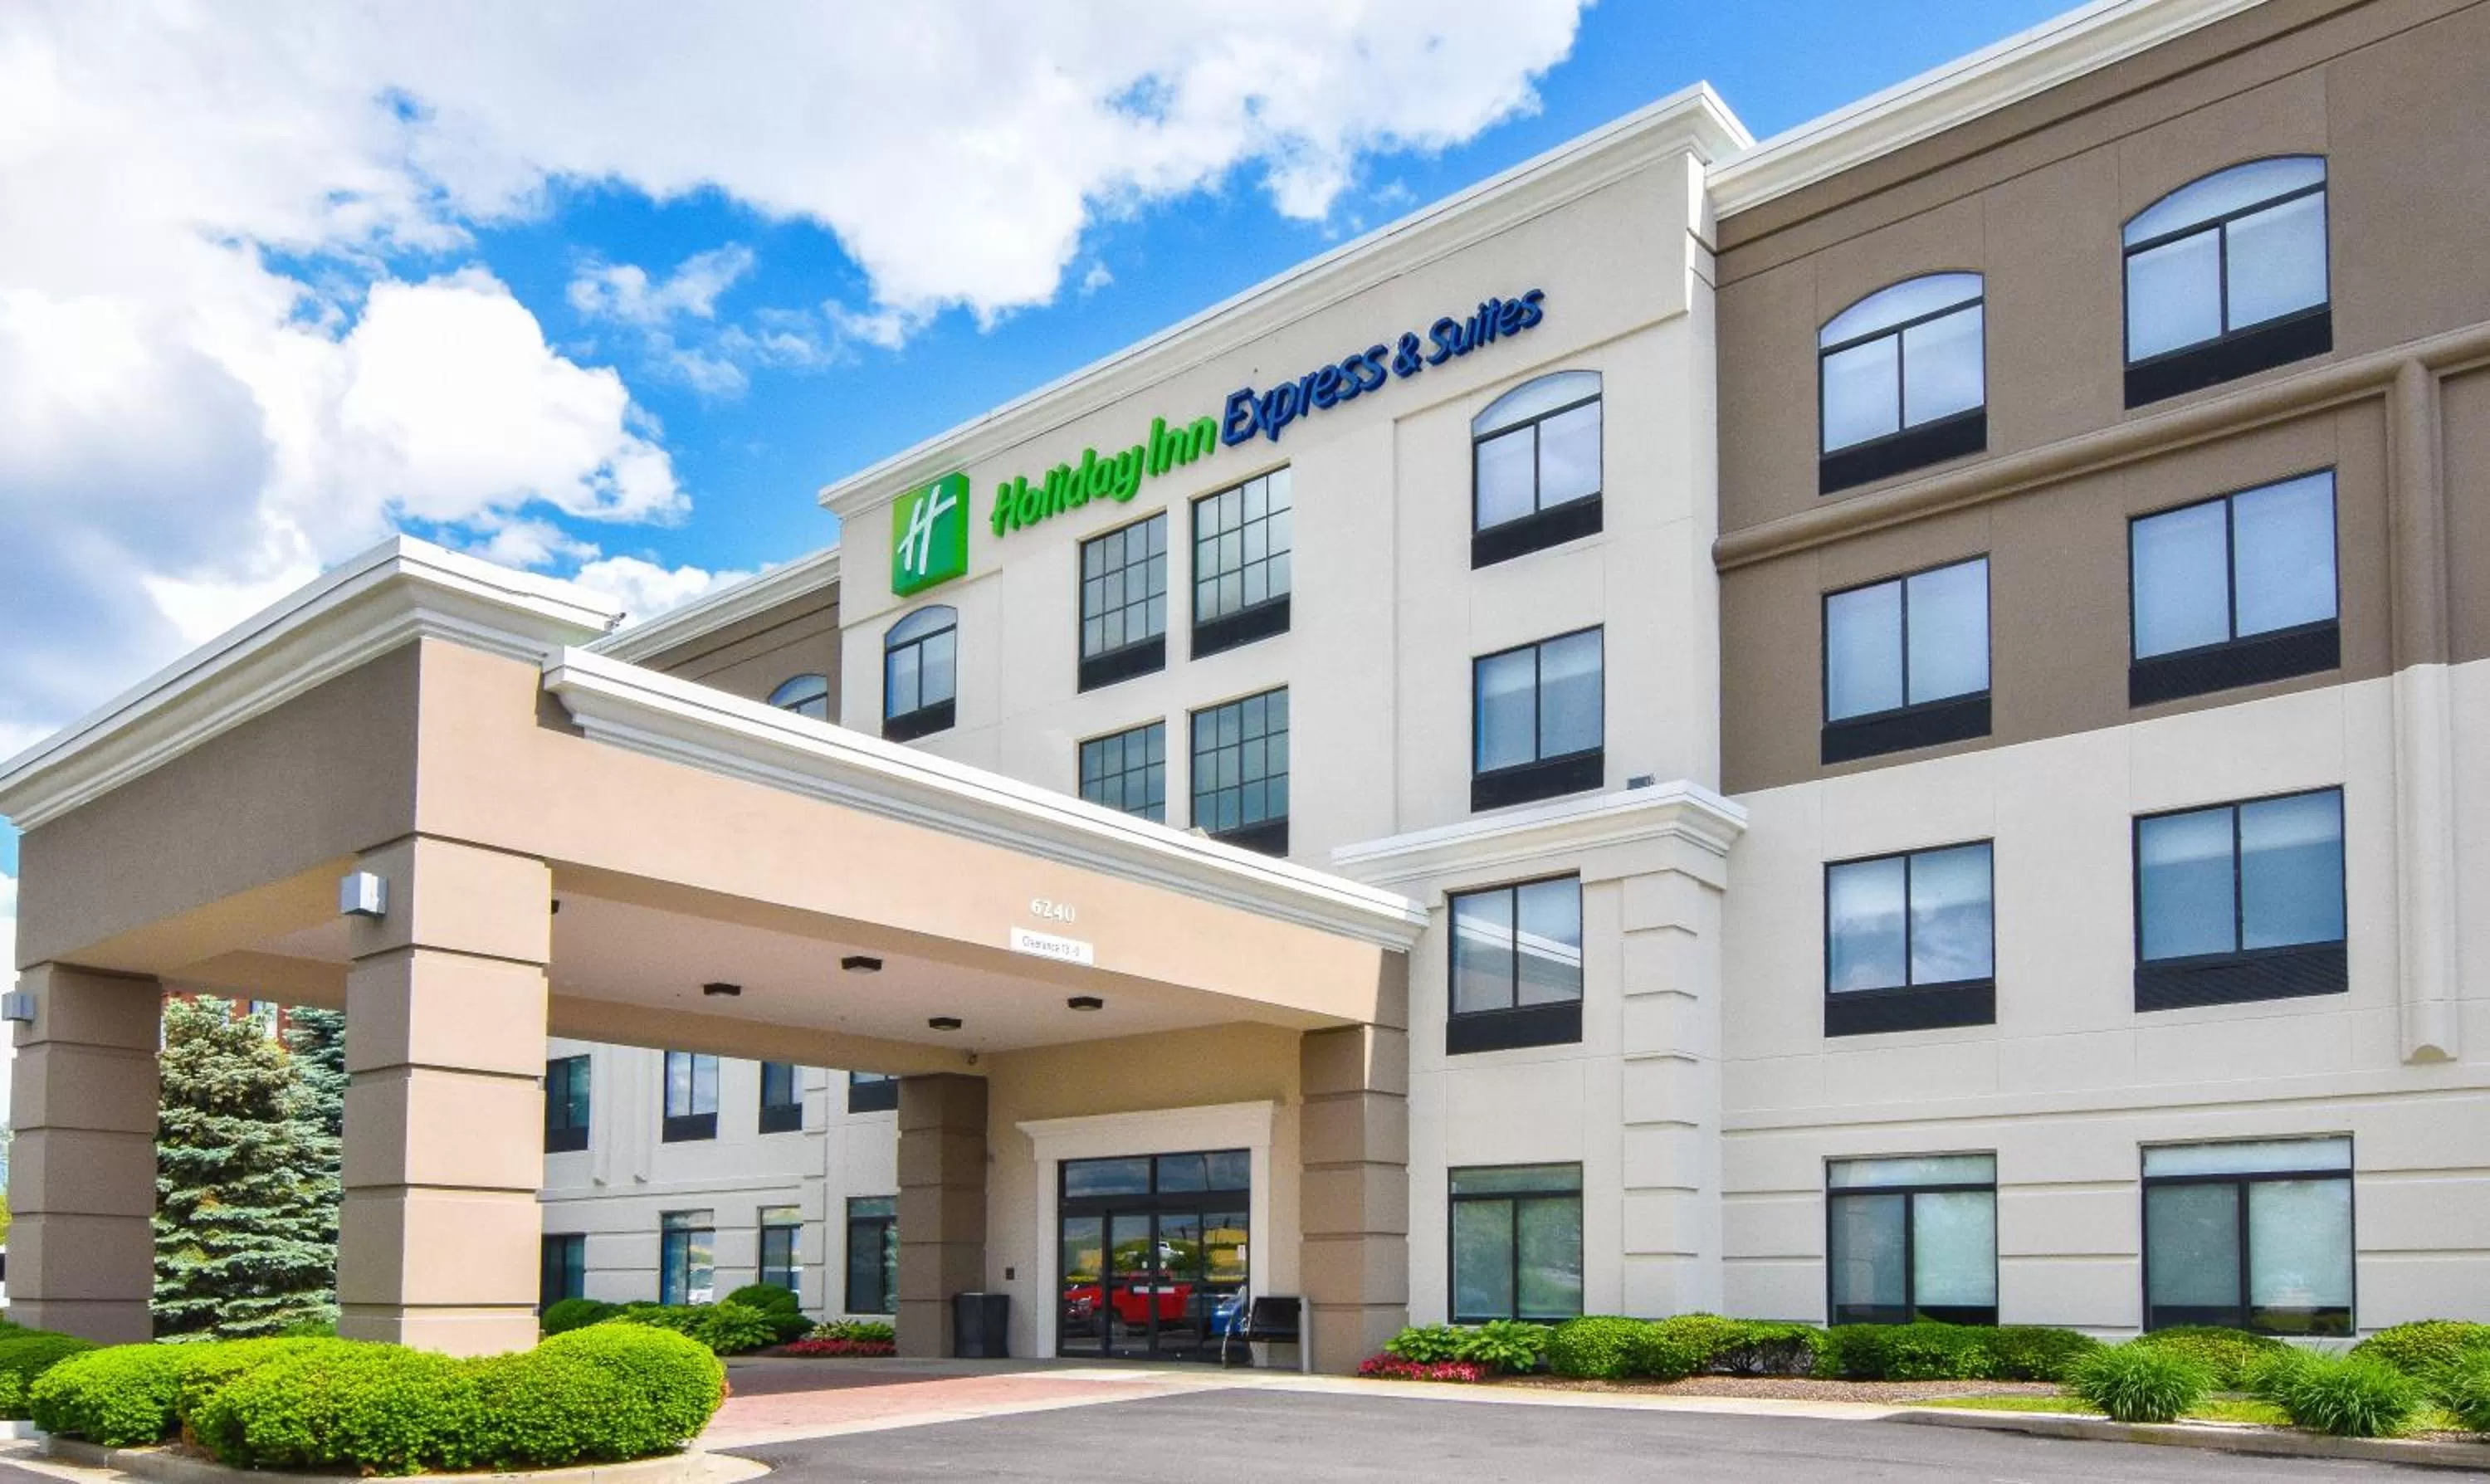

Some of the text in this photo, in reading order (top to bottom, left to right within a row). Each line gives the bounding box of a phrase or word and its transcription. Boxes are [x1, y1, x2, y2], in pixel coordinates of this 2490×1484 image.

[989, 288, 1545, 538] Holiday Inn Express & Suites
[897, 484, 957, 574] H
[1030, 899, 1076, 924] 6240
